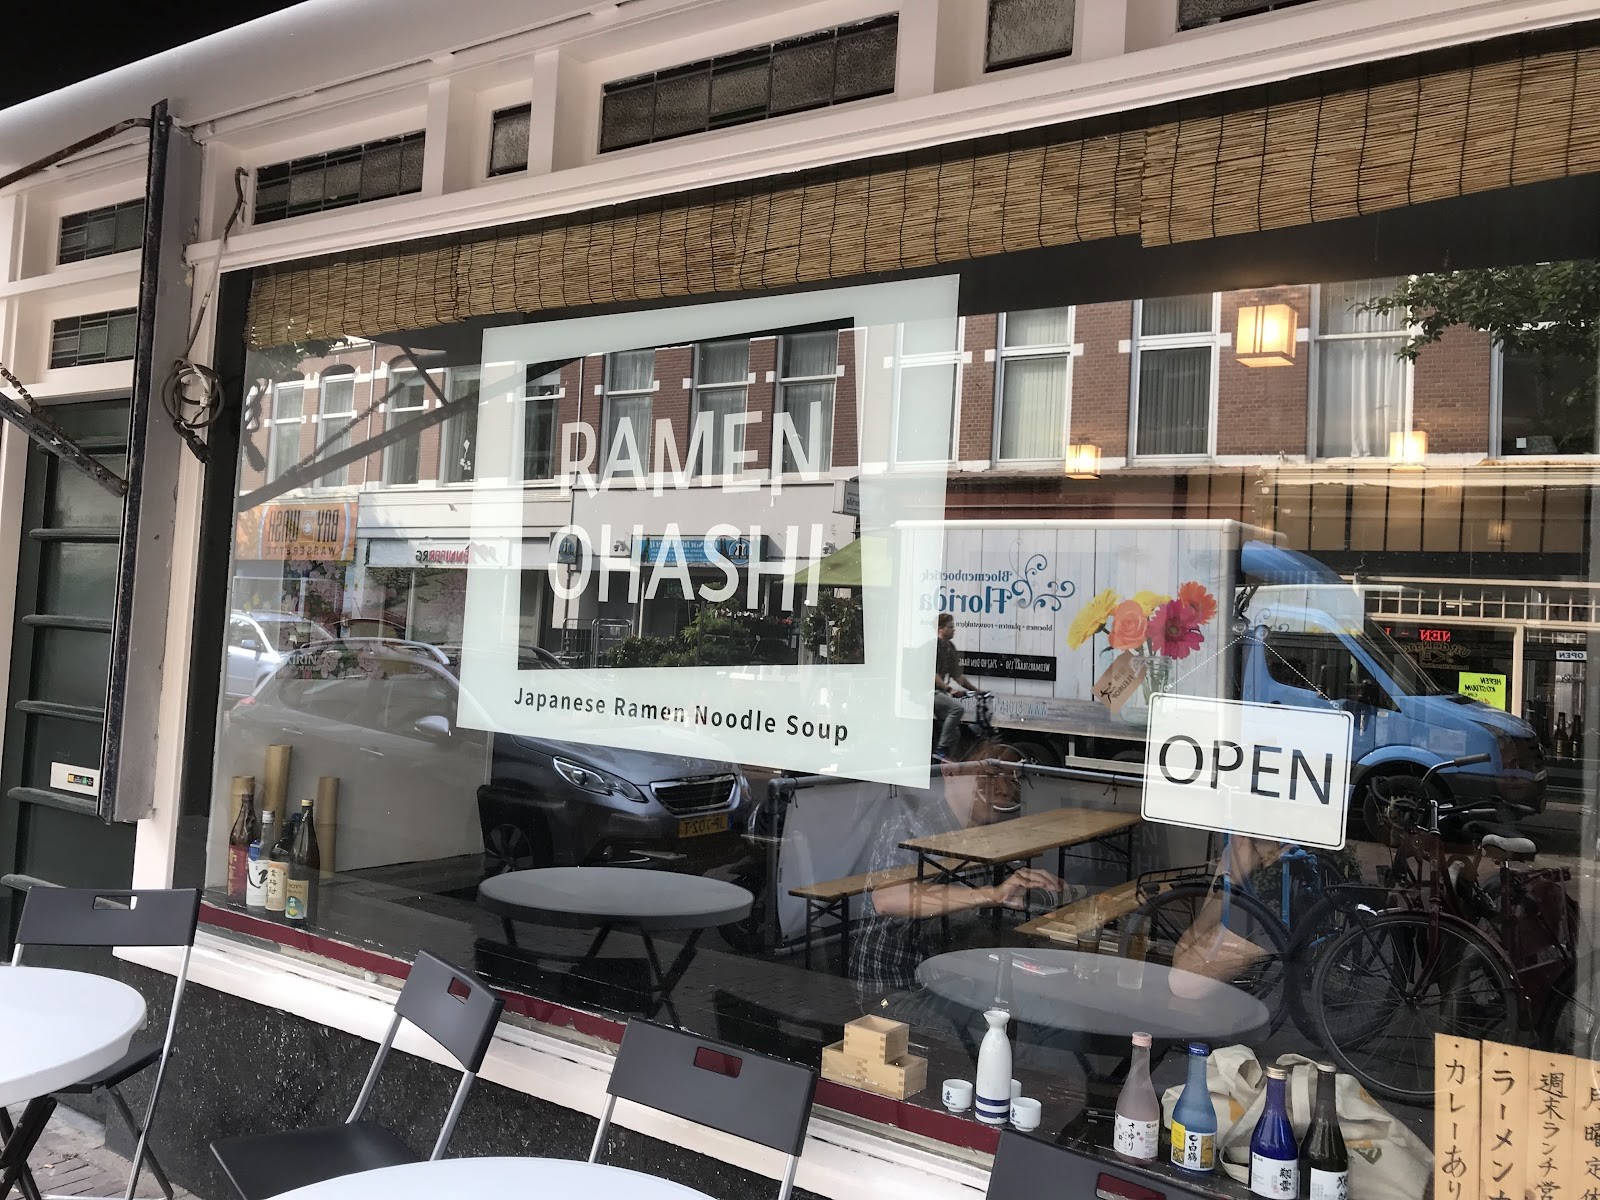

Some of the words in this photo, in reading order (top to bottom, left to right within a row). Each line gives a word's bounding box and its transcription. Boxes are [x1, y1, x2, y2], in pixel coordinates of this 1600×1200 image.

[560, 401, 822, 499] RAMEN
[547, 522, 824, 611] OHASHI
[514, 686, 606, 716] Japanese
[613, 697, 686, 724] Ramen
[694, 705, 777, 733] Noodle
[785, 715, 849, 745] Soup
[1159, 735, 1333, 805] OPEN
[1490, 1070, 1516, 1200] ラーメン
